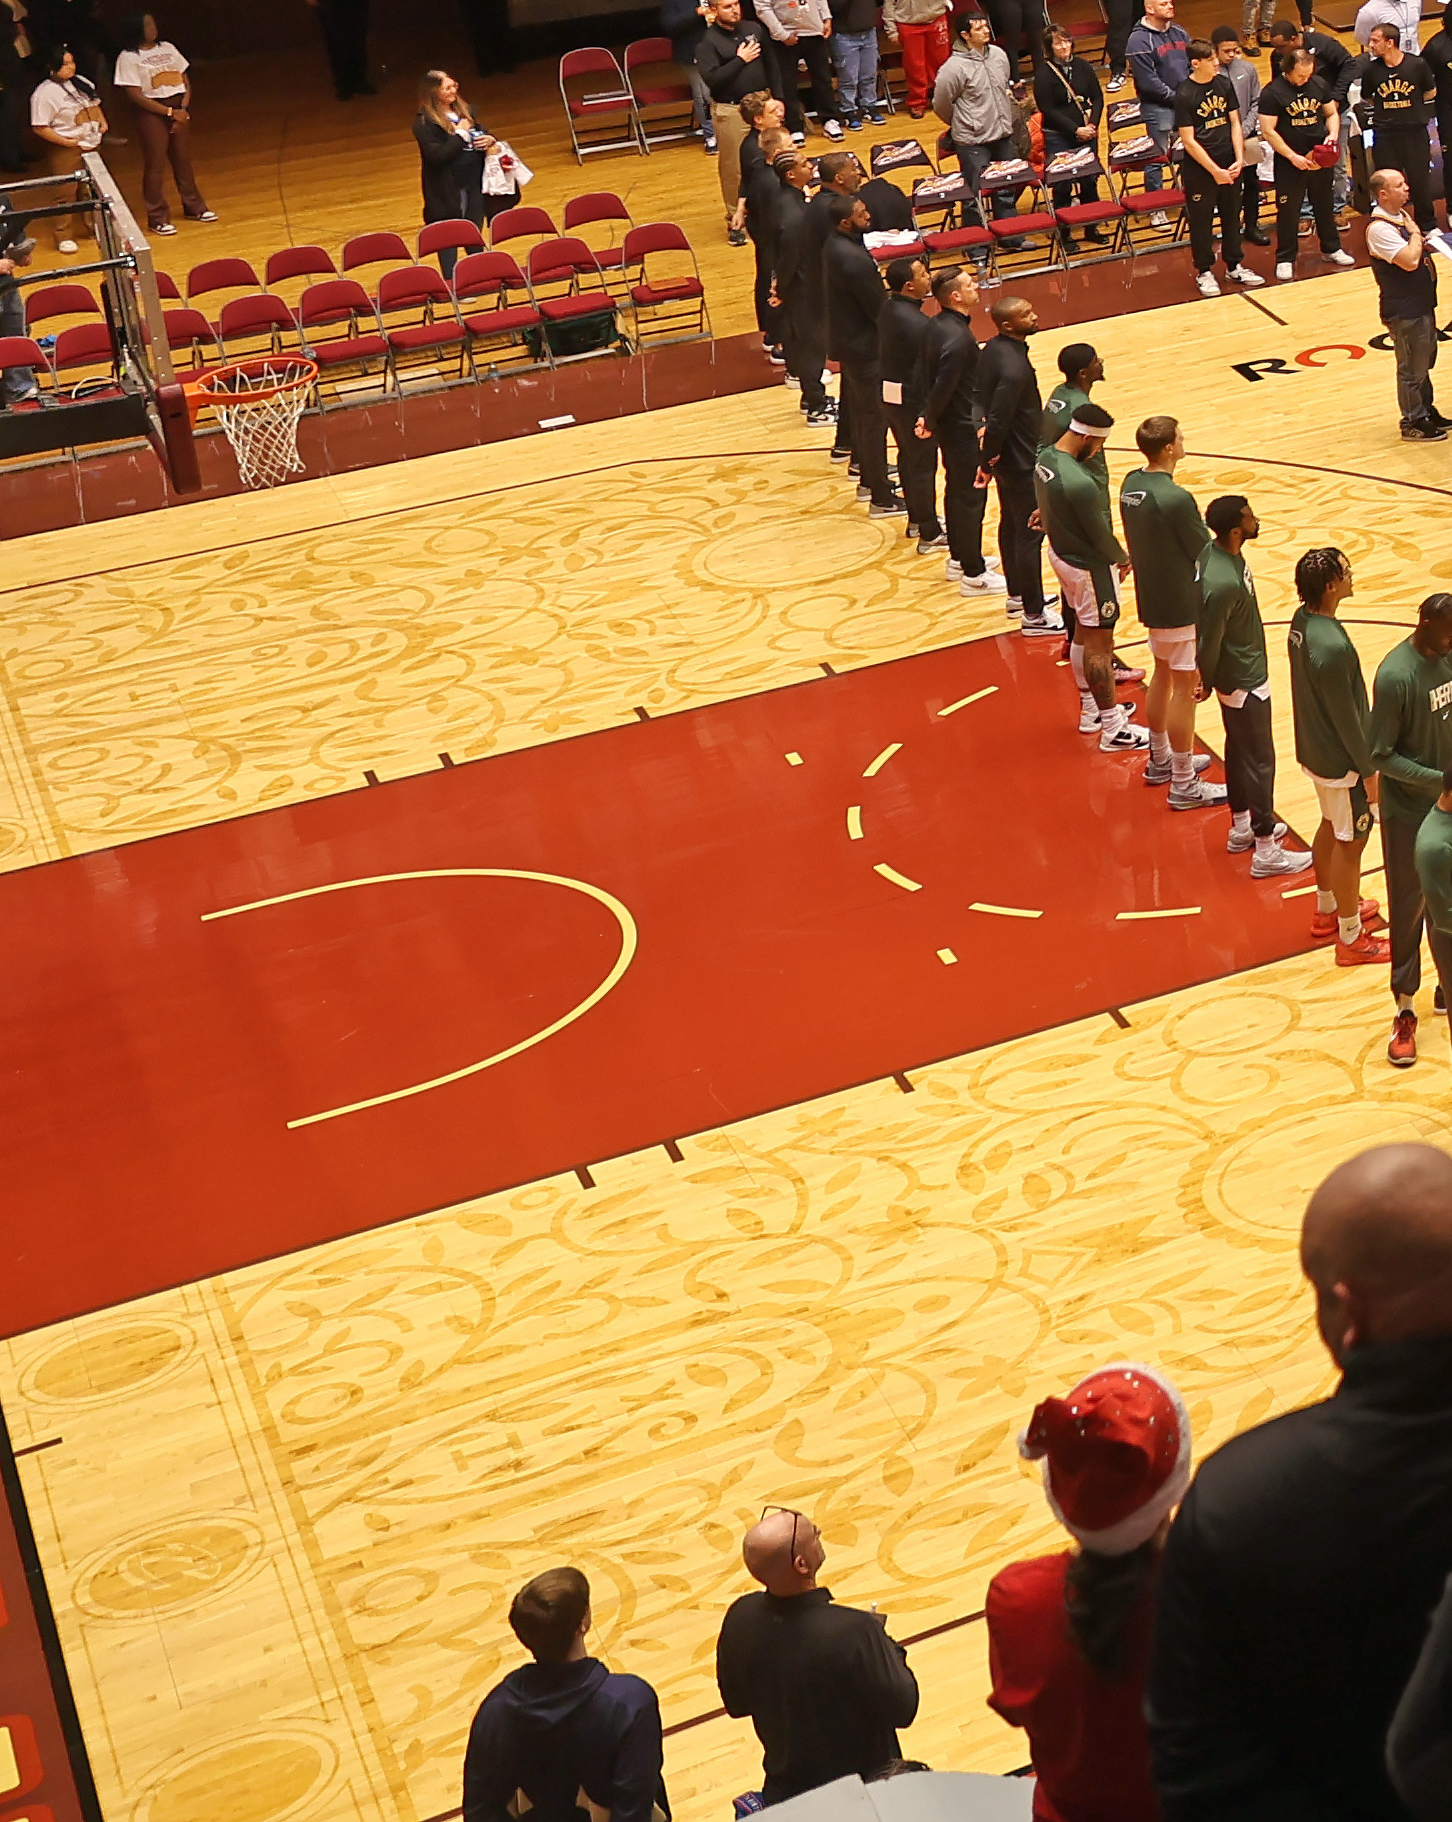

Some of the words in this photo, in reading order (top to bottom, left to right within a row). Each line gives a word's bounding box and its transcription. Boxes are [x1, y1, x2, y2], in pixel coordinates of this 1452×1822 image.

[1377, 79, 1415, 97] CHARGE
[1197, 95, 1227, 117] CHARGE
[1286, 97, 1322, 116] CHARGE
